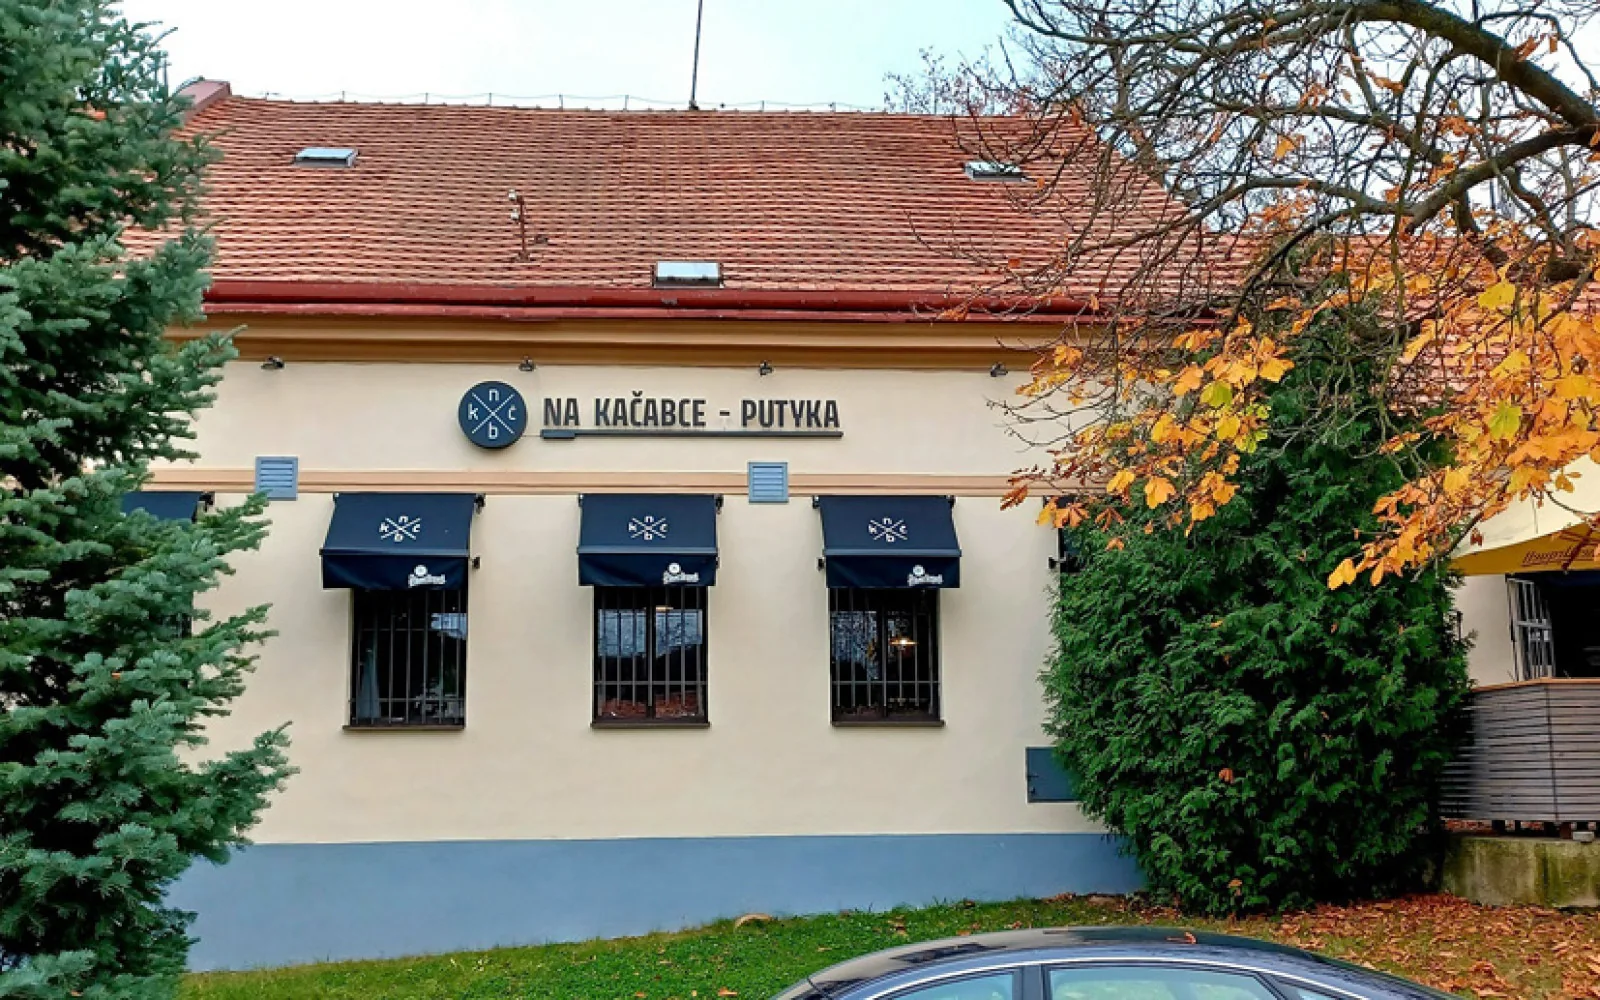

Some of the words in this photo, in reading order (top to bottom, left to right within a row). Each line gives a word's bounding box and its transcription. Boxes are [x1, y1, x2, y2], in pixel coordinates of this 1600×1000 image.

[489, 389, 500, 401] n
[467, 403, 479, 421] k
[543, 398, 580, 427] NA
[595, 390, 707, 428] KAČABCE
[742, 399, 841, 428] PUTYKA
[488, 421, 498, 440] b
